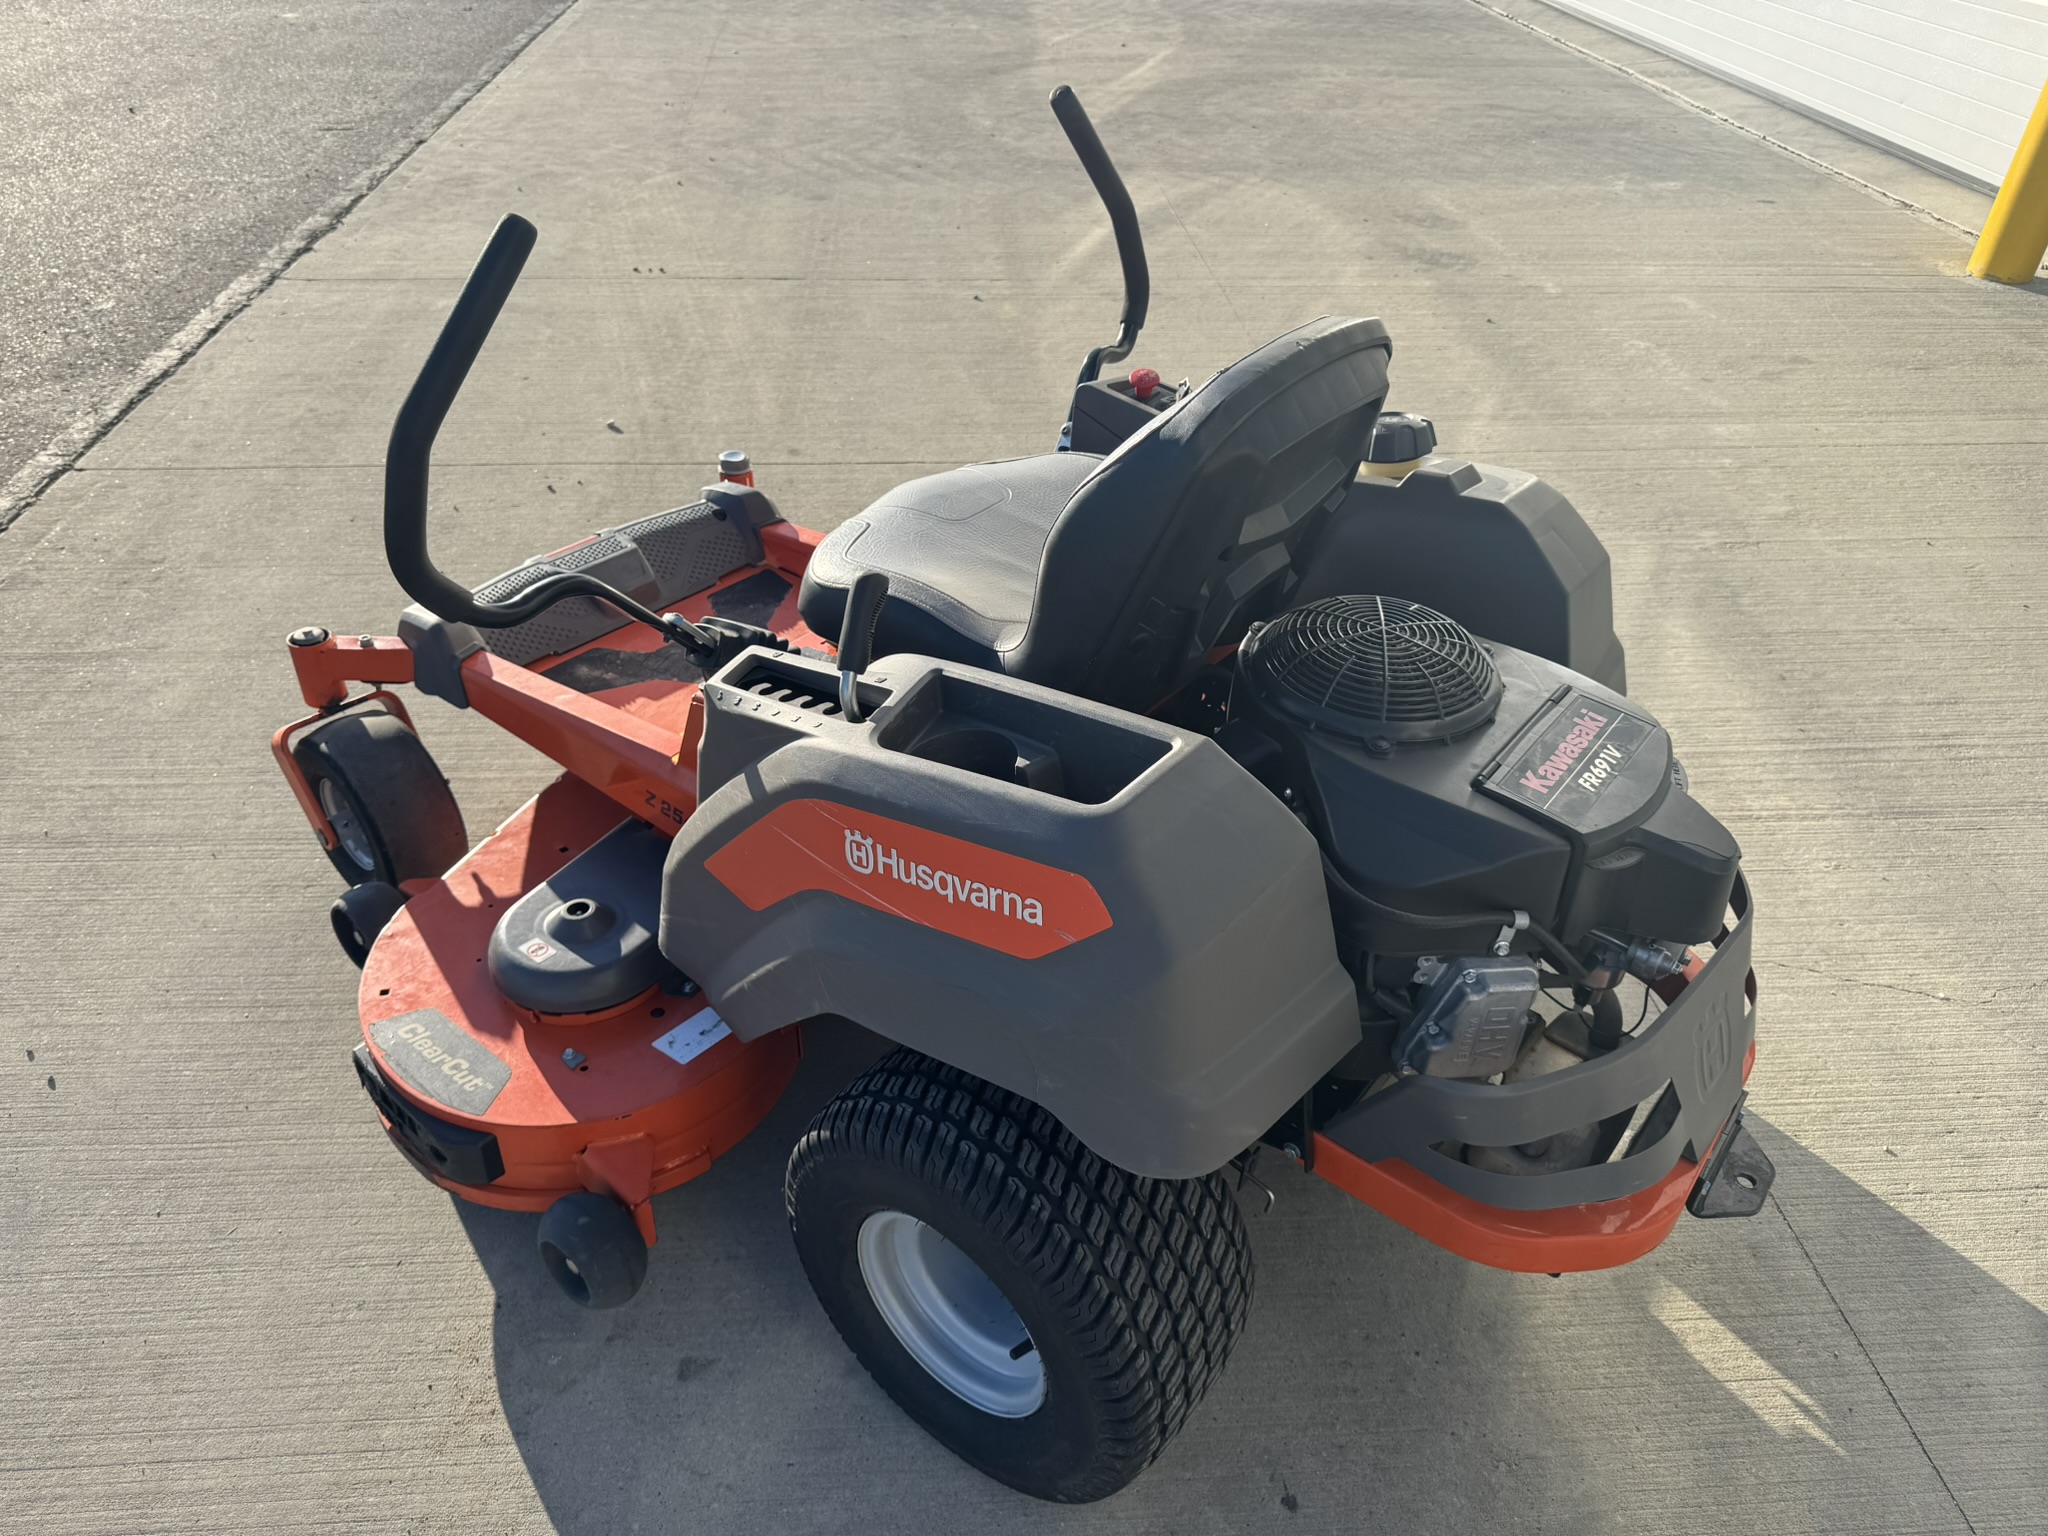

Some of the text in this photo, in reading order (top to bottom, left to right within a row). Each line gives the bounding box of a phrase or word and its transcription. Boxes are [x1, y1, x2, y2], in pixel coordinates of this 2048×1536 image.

[1519, 708, 1608, 794] Kawasaki
[1577, 744, 1623, 792] FR691V
[645, 789, 686, 825] Z 25
[876, 843, 1043, 927] Husqvarna
